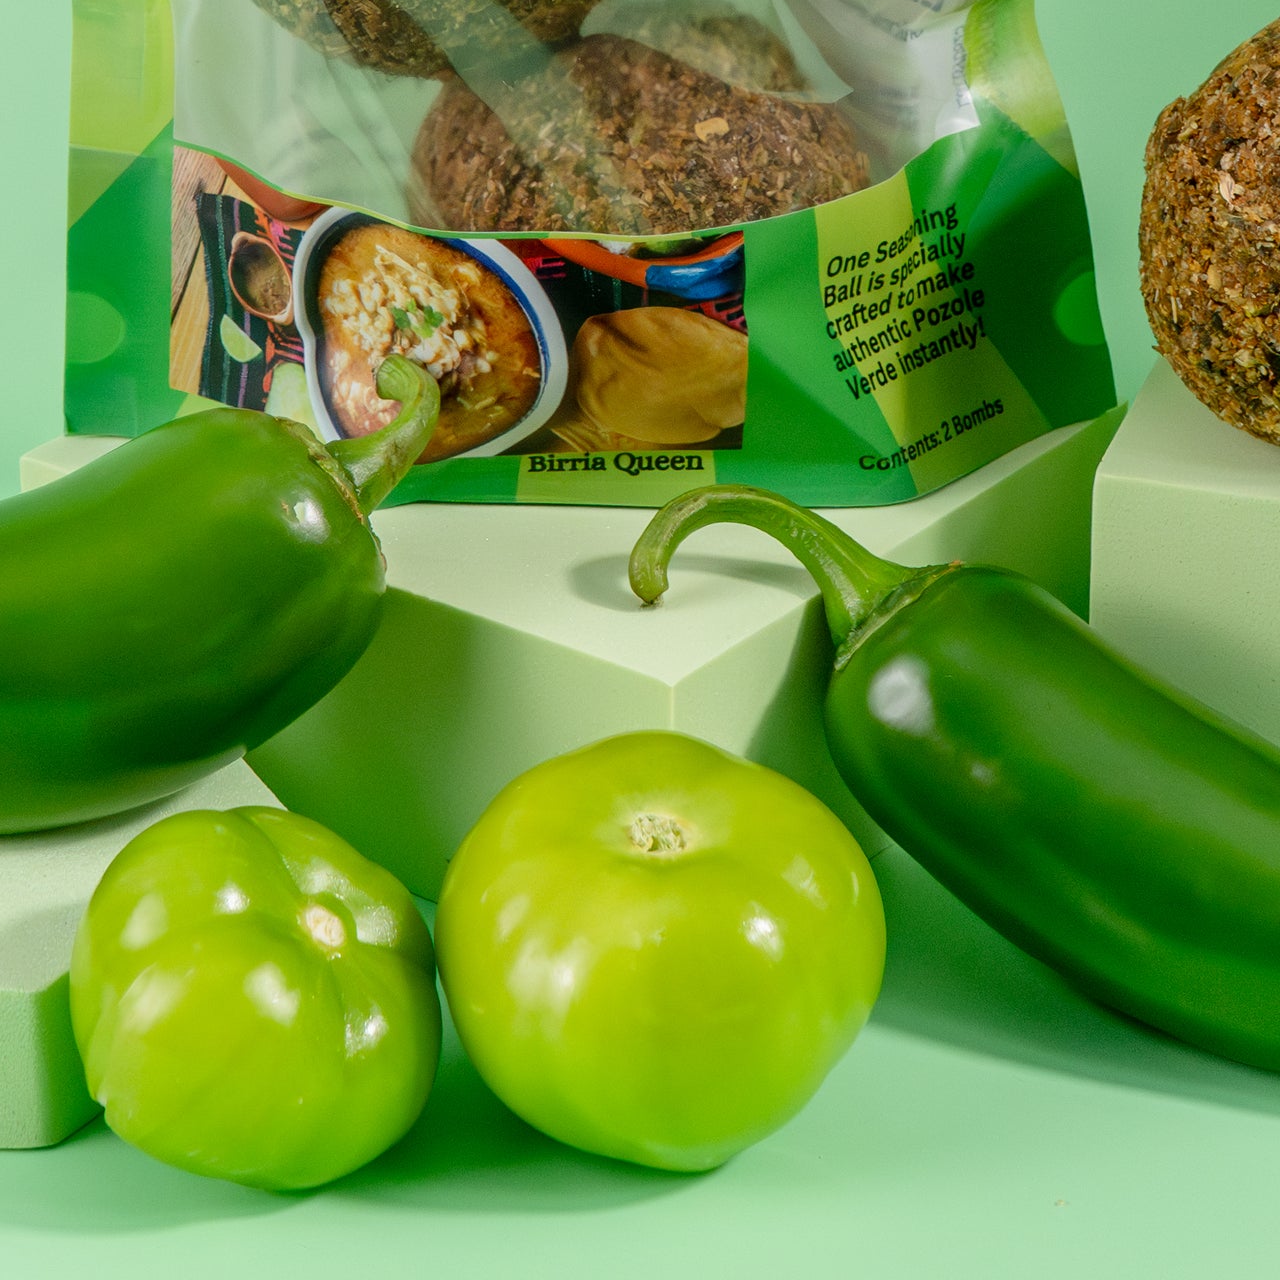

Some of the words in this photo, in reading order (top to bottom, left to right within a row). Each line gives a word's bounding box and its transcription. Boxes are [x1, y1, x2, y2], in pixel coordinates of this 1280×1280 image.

[824, 275, 862, 308] Ball
[868, 271, 885, 292] is
[890, 233, 966, 288] specially
[826, 292, 892, 339] crafted
[898, 288, 915, 309] to
[916, 262, 975, 299] make
[827, 252, 870, 277] One
[833, 318, 912, 372] authentic
[913, 287, 984, 332] Pozole
[845, 361, 898, 400] Verde
[896, 315, 986, 374] instantly!
[527, 452, 607, 472] Birria
[613, 451, 704, 476] Queen
[859, 430, 942, 470] Contents:
[941, 420, 953, 443] 2
[951, 399, 1004, 436] Bombs
